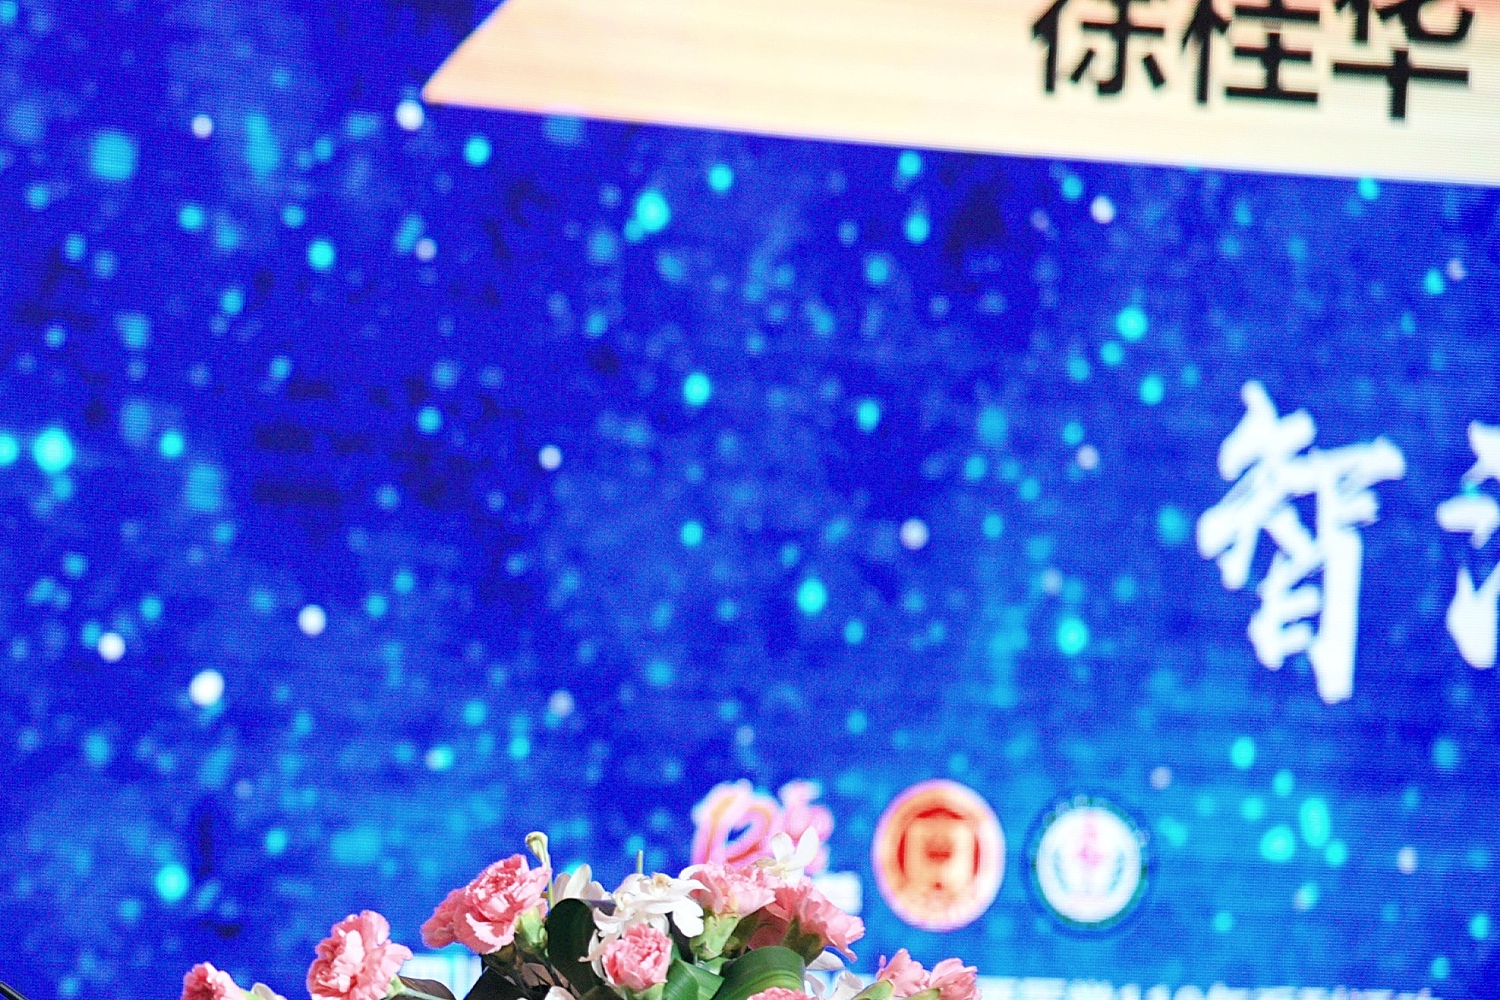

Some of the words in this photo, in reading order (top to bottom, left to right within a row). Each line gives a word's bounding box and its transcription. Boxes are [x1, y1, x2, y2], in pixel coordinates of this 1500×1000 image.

[1030, 0, 1472, 121] 徐桂华
[1197, 380, 1500, 704] 智
